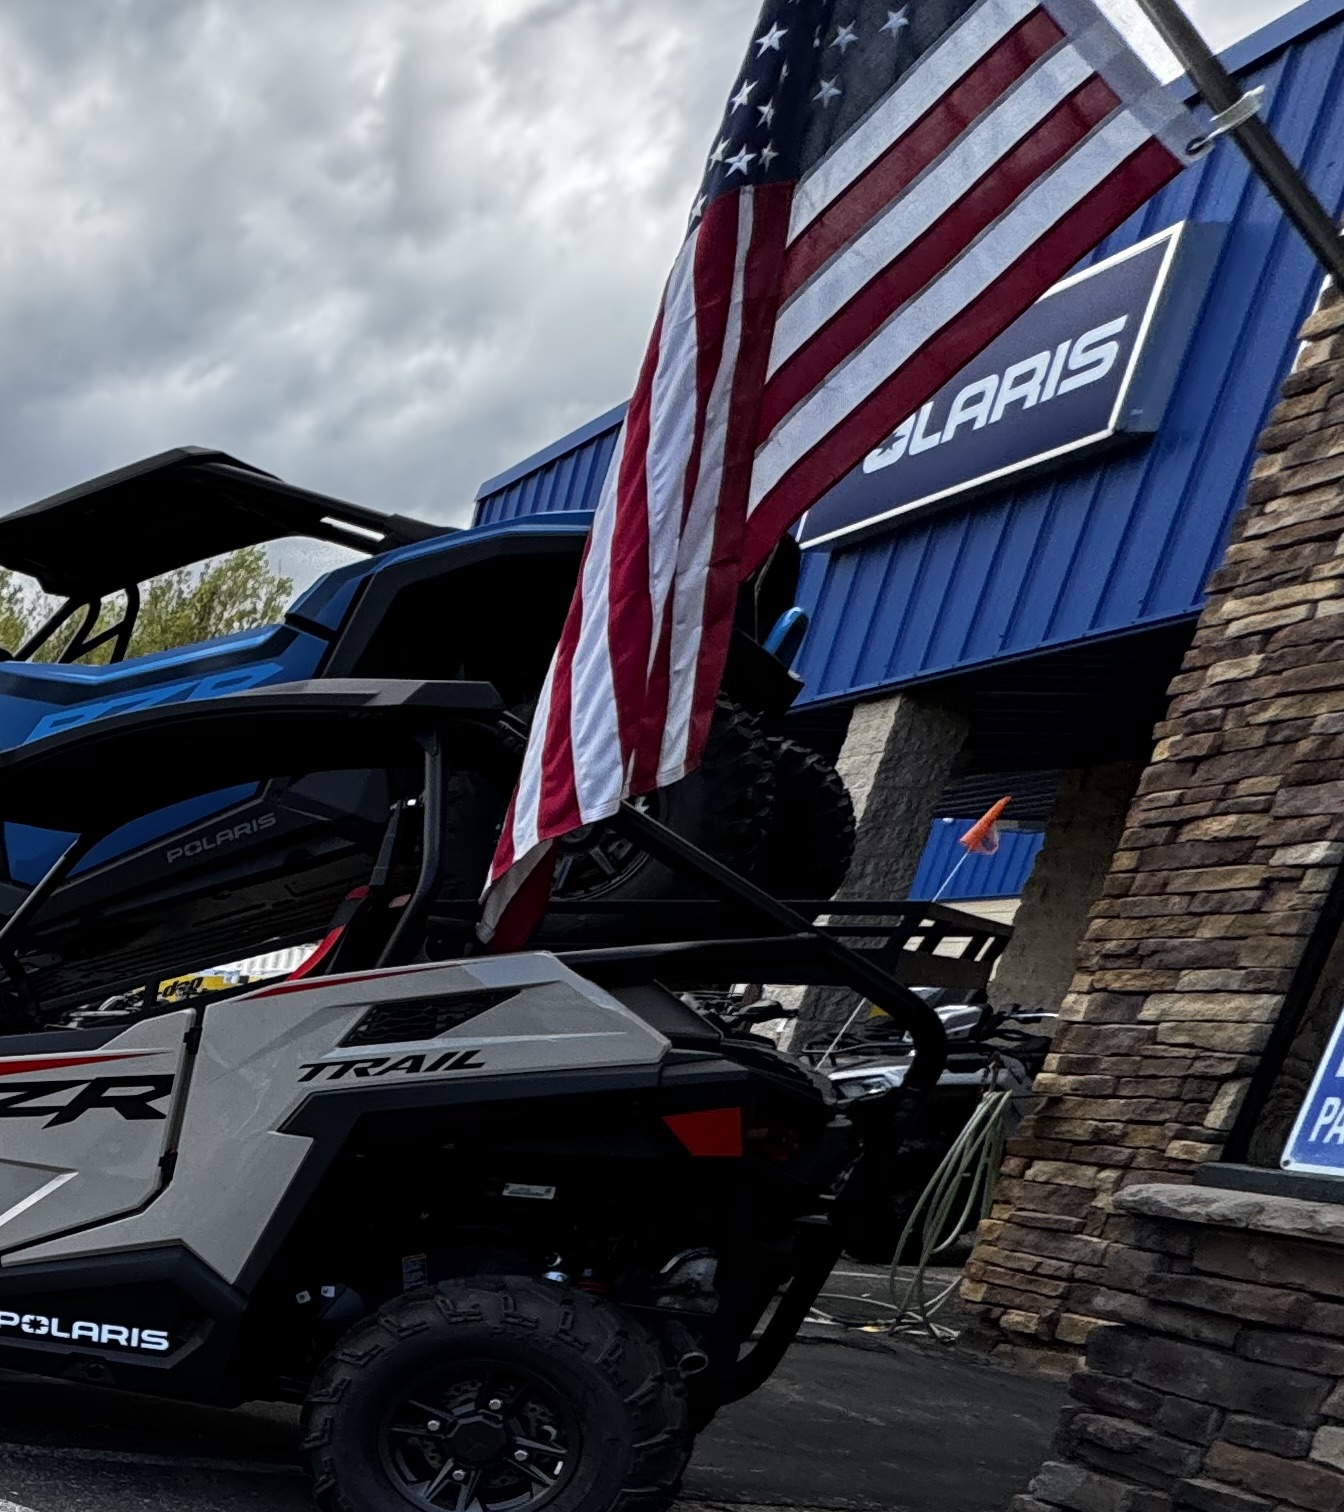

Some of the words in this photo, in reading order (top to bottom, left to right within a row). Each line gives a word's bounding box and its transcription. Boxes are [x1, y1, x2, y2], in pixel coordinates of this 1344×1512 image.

[862, 315, 1129, 475] OLARIS
[166, 812, 277, 864] POLARIS
[297, 1049, 486, 1083] TRAIL
